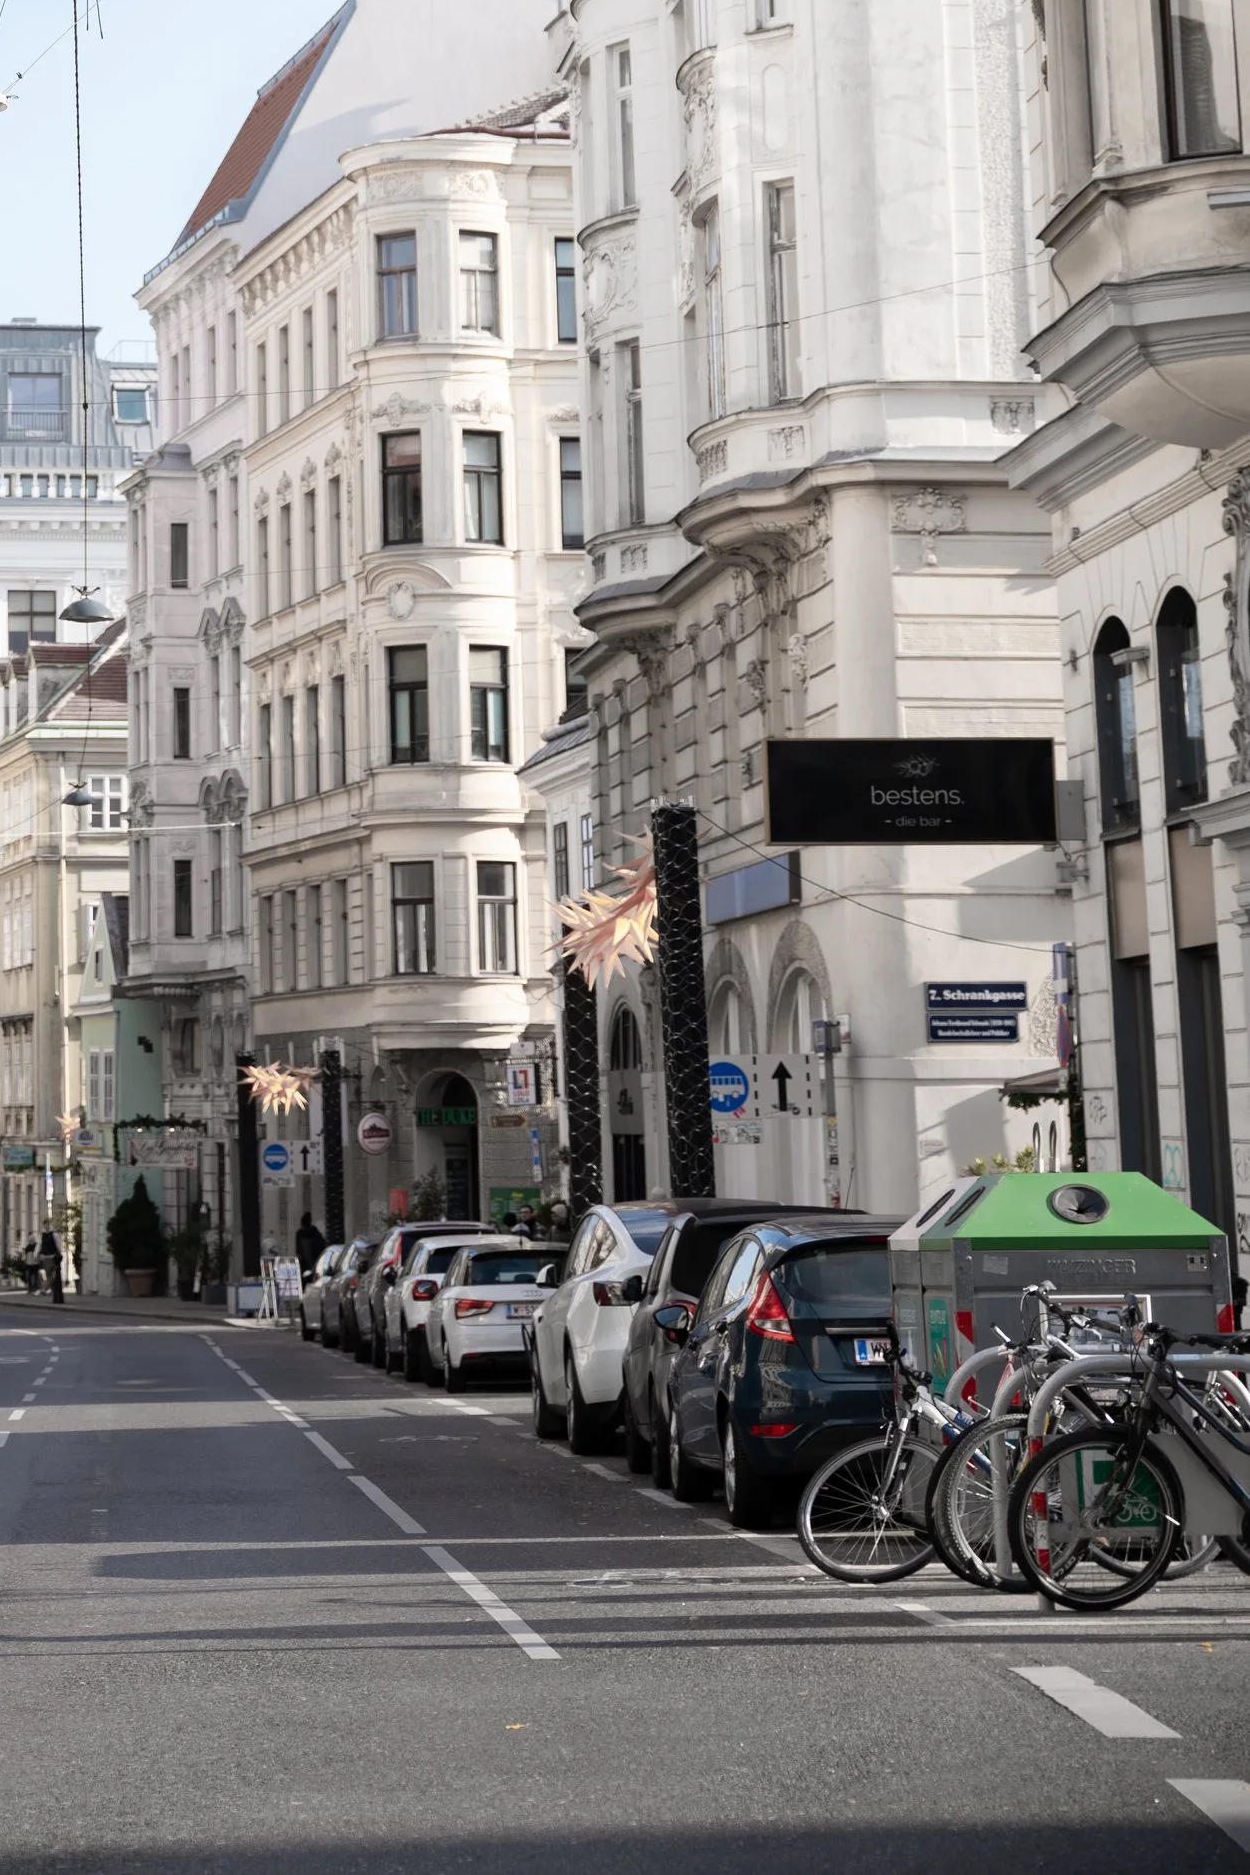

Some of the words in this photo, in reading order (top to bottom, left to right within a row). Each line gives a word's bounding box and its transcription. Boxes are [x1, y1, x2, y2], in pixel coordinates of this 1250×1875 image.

[871, 785, 965, 805] bestens.
[895, 816, 916, 827] die
[919, 816, 941, 827] bar
[943, 989, 1026, 1003] Schrankgasse
